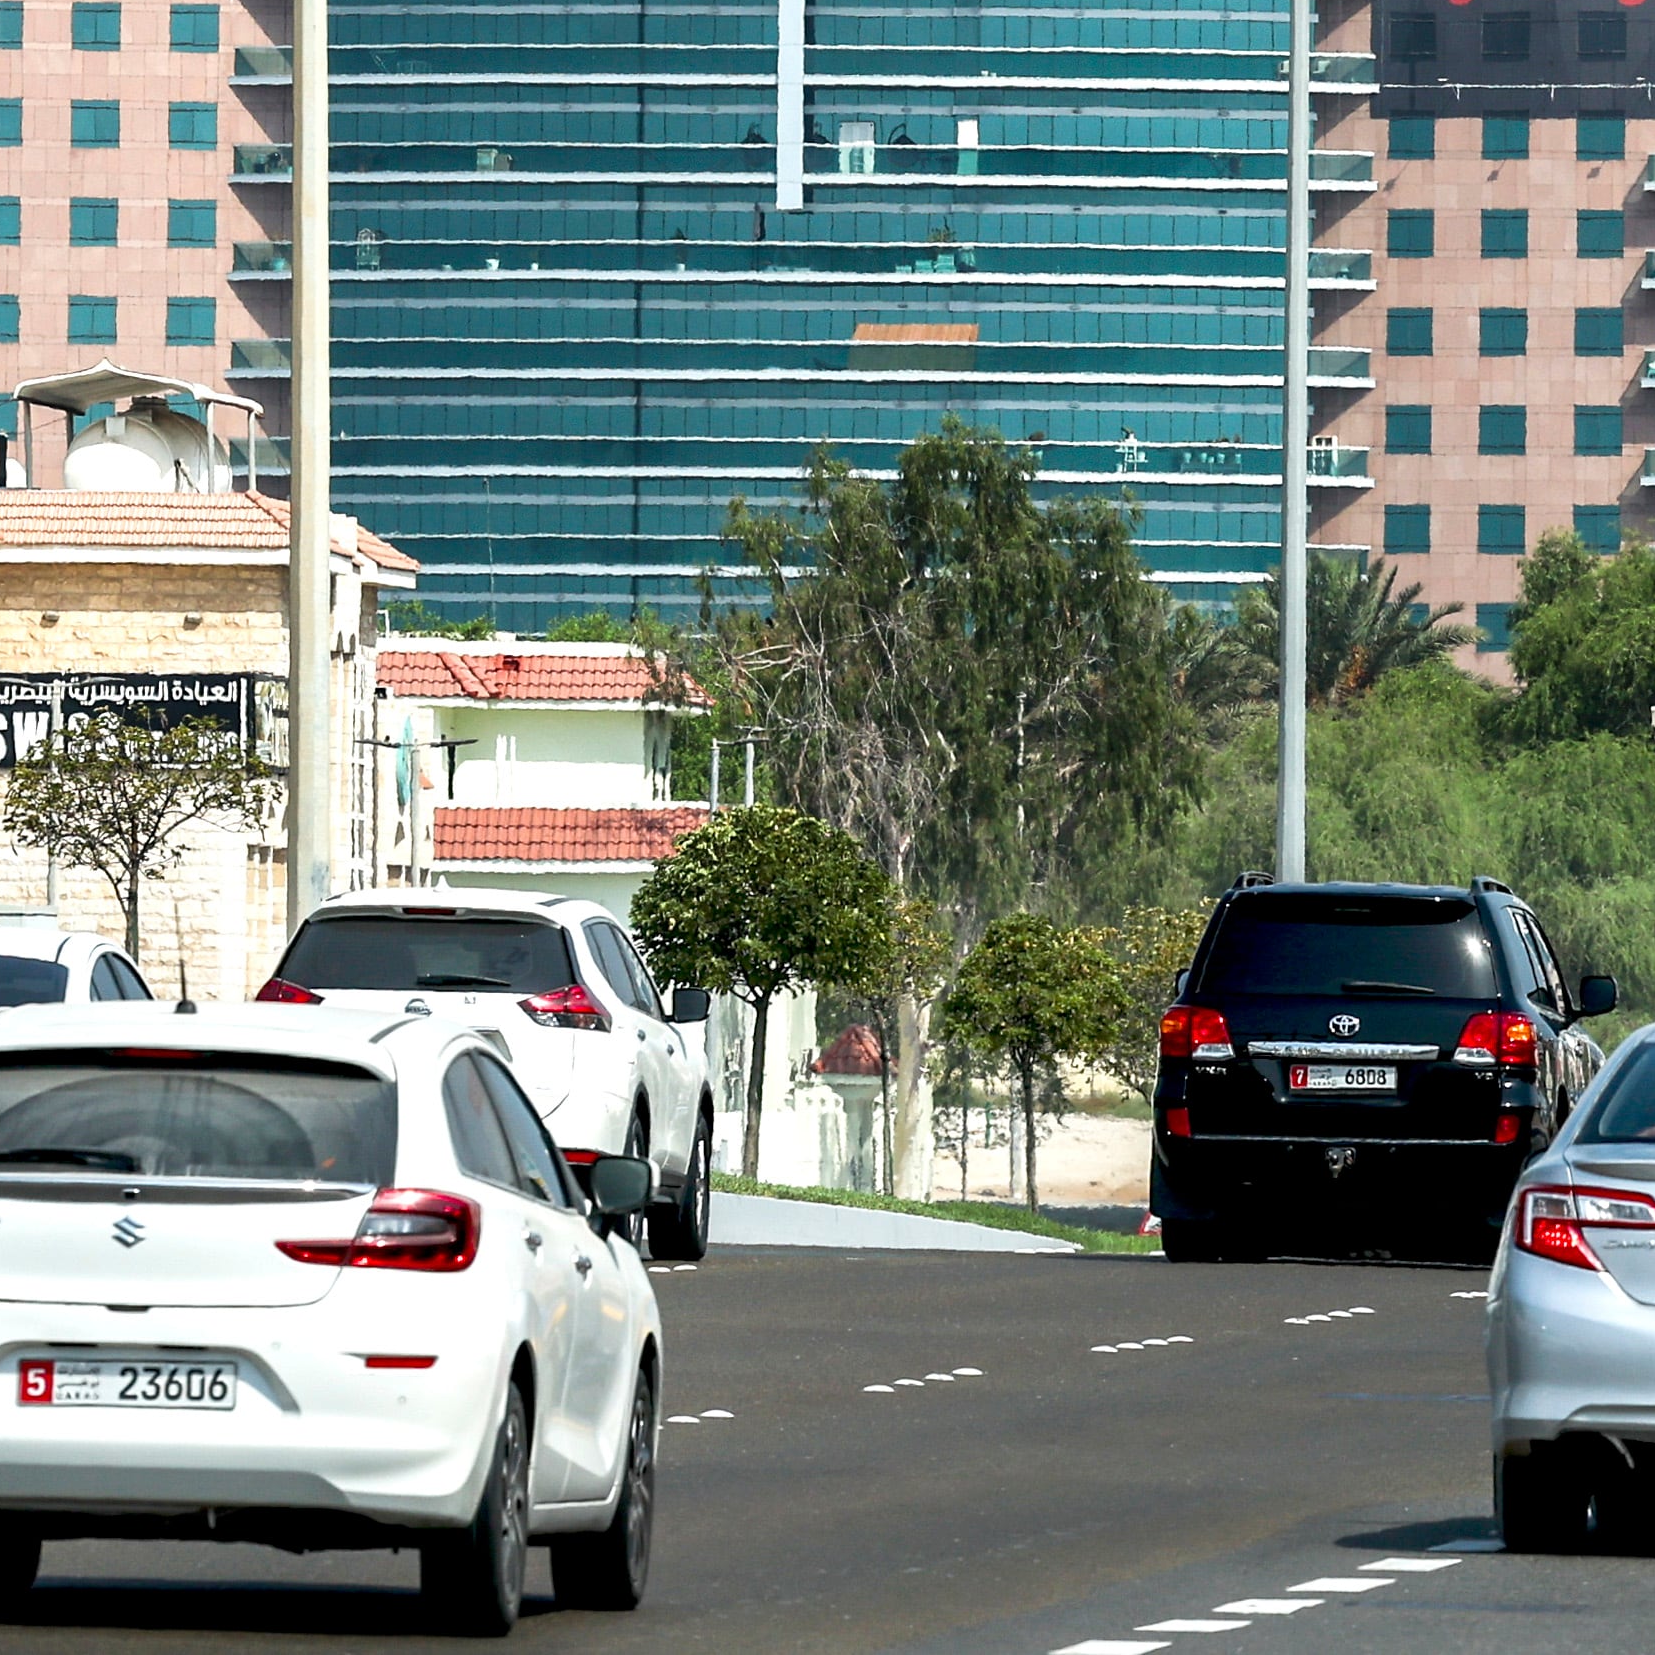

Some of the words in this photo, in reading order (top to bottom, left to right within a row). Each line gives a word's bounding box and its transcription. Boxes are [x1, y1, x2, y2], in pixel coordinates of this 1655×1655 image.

[171, 679, 238, 706] العيادة
[1296, 1069, 1305, 1085] 7
[1344, 1068, 1388, 1086] 6808
[26, 1367, 46, 1397] 5
[118, 1366, 229, 1401] 23606
